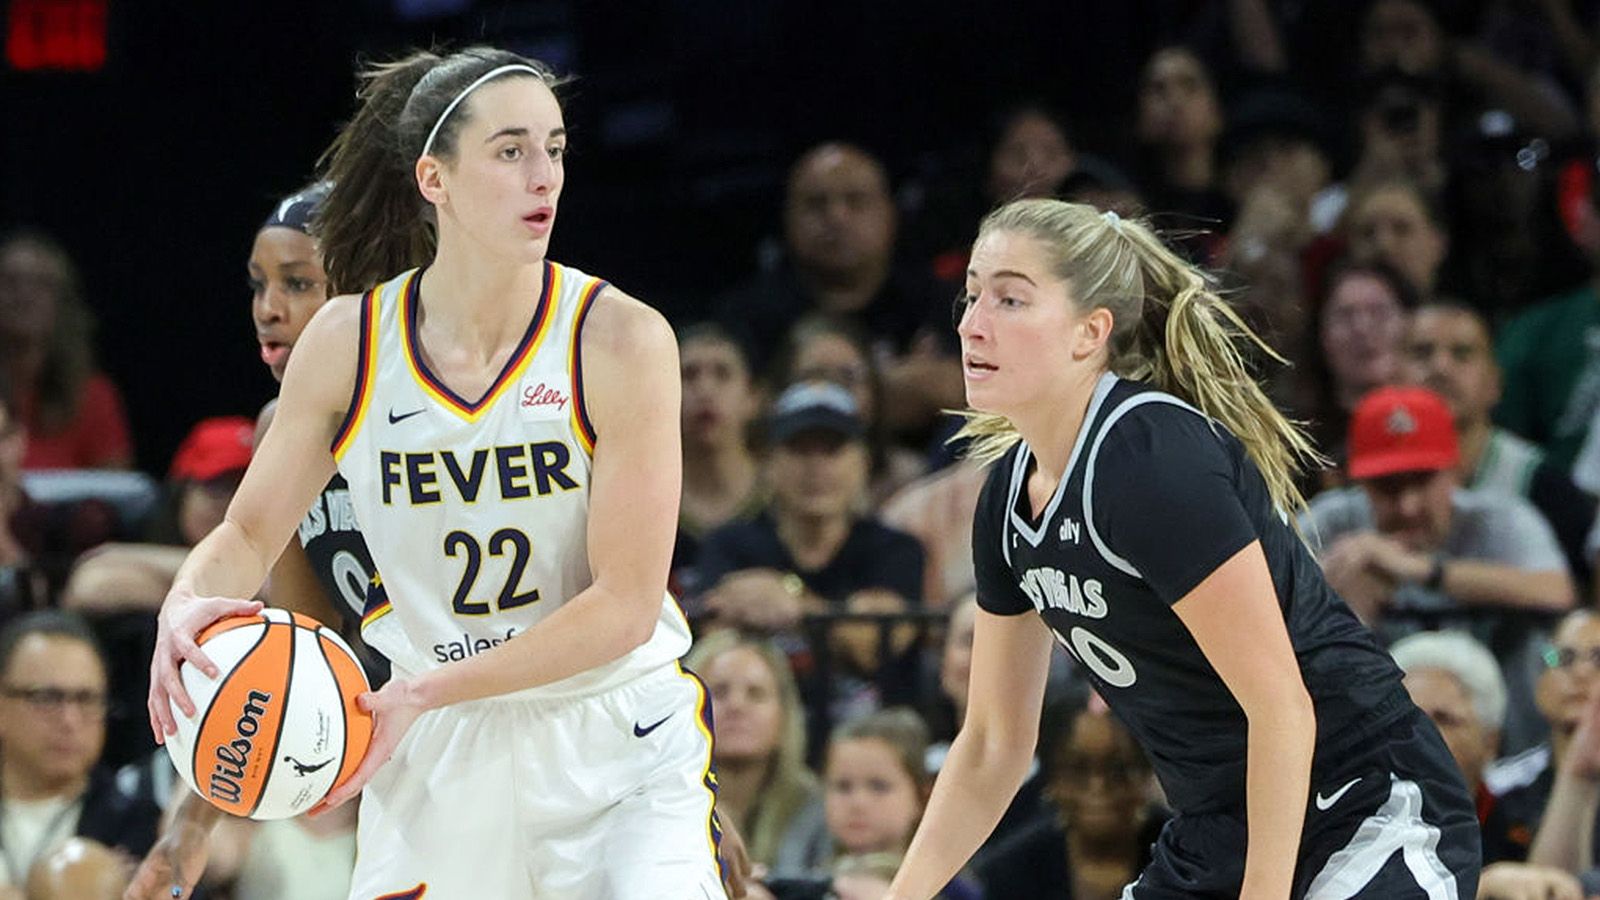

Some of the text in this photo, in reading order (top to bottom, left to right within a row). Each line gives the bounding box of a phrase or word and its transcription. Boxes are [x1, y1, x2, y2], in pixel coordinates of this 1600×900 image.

[521, 383, 568, 411] Lilly
[380, 440, 581, 507] FEVER
[332, 550, 370, 616] 0
[443, 525, 542, 616] 22
[1052, 626, 1137, 688] 0
[210, 690, 271, 803] Wilson
